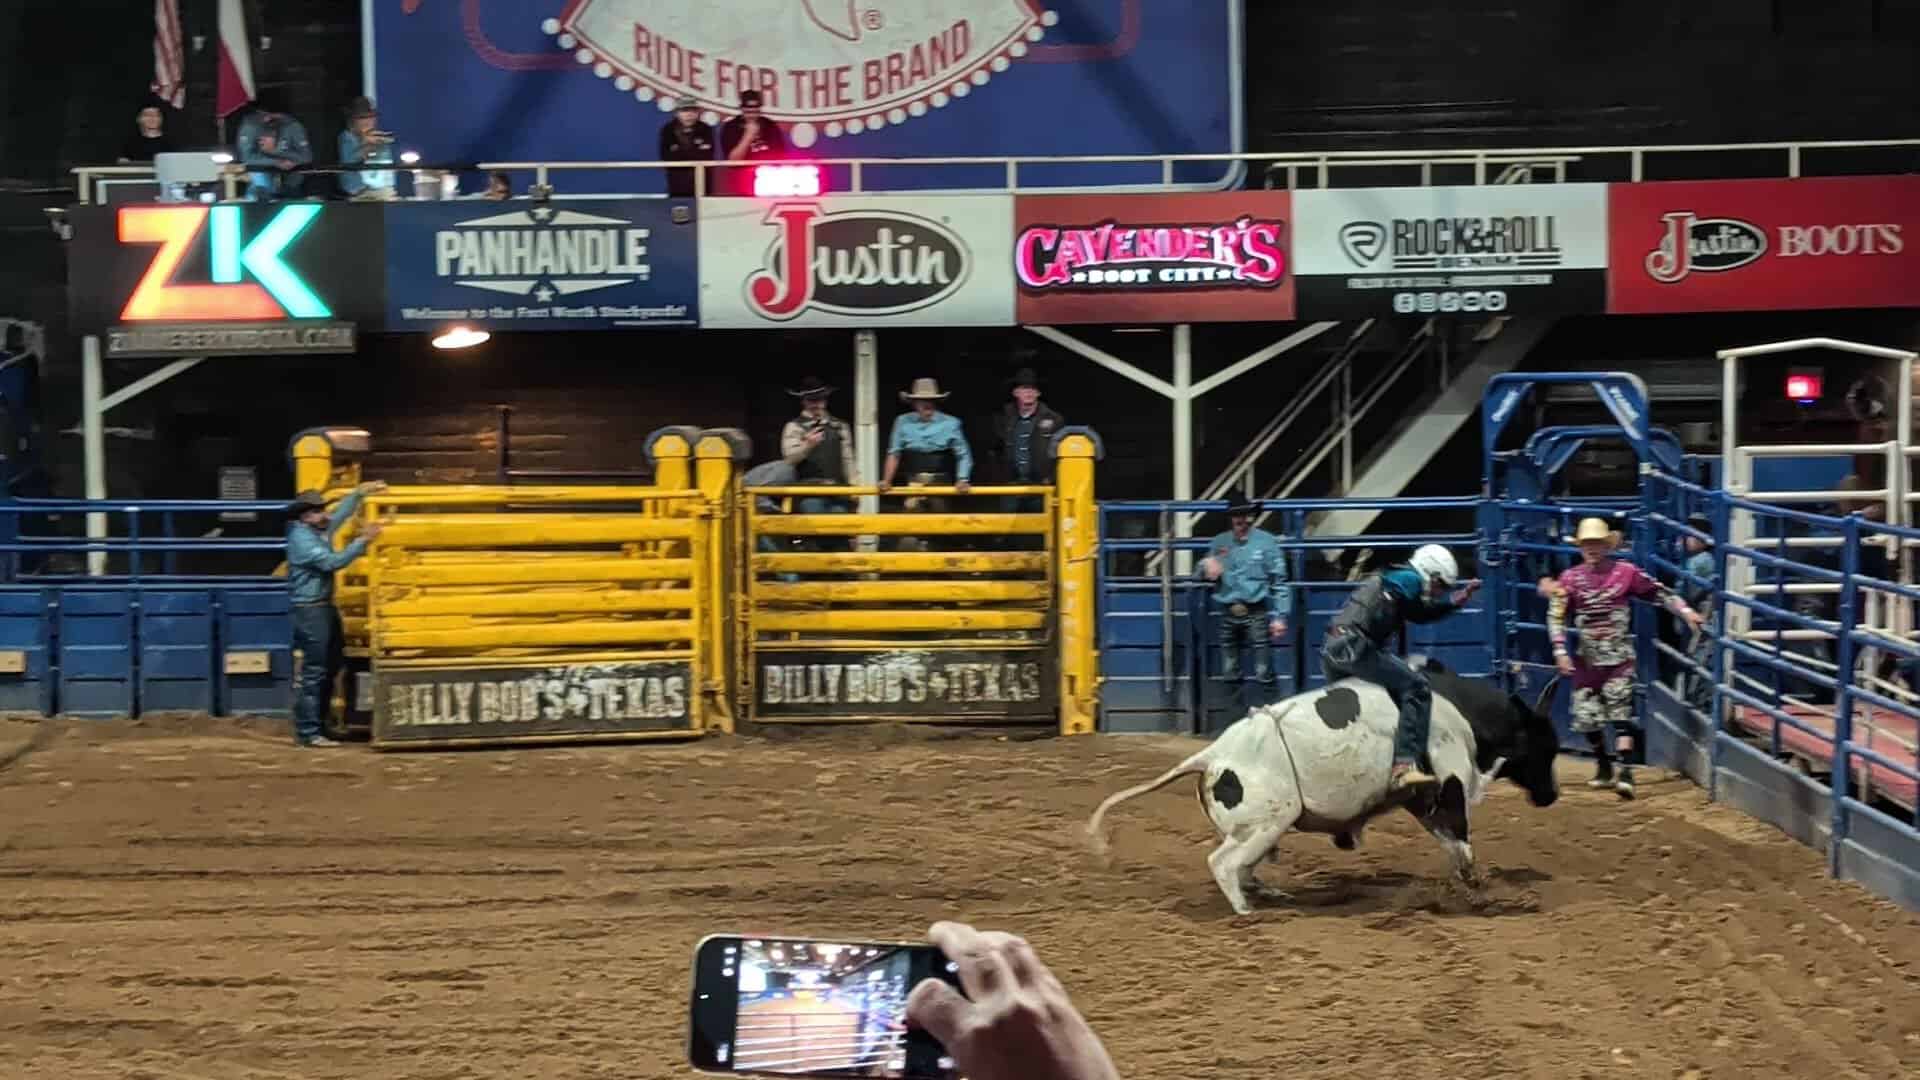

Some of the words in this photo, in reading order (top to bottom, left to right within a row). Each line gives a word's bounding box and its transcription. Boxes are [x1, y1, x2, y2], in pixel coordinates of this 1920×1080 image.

[634, 22, 706, 92] RIDE
[714, 59, 779, 108] FOR
[787, 65, 852, 109] THE
[863, 19, 969, 101] BRAND
[436, 229, 650, 276] PANHANDLE
[1016, 219, 1284, 286] CAVENDER'S
[1392, 215, 1561, 256] ROCK&ROLL
[1645, 212, 1757, 282] Justin
[1776, 224, 1904, 257] BOOTS
[745, 202, 951, 321] Justin
[1088, 269, 1151, 283] BOOT
[1159, 268, 1217, 282] CITY
[389, 682, 474, 725] BILLY
[478, 677, 566, 722] BOB'S
[586, 676, 686, 720] TEXAS
[764, 664, 842, 703] BILLY
[845, 661, 928, 703] BOB'S
[944, 663, 1040, 702] TEXAS
